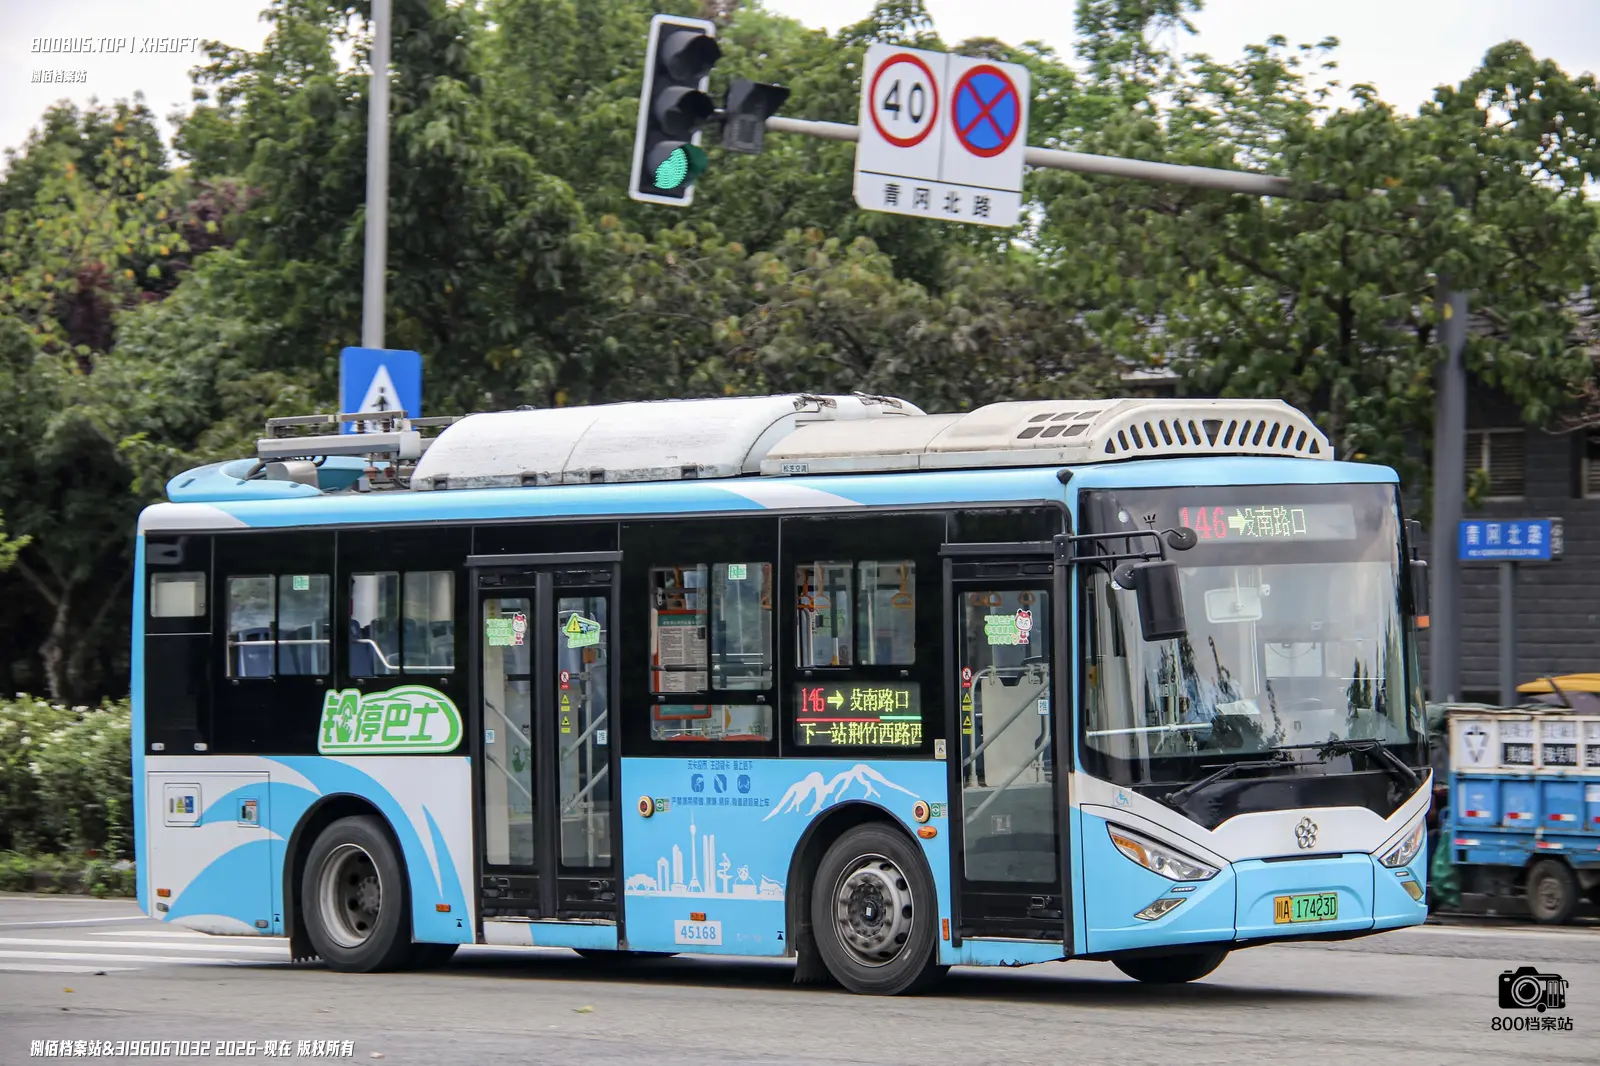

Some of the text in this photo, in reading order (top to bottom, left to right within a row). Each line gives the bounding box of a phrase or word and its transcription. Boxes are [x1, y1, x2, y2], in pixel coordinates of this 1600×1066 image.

[882, 79, 925, 124] 40
[884, 182, 992, 218] 青冈北路
[1181, 506, 1227, 539] 146
[801, 687, 825, 712] 146
[680, 926, 716, 940] 45168
